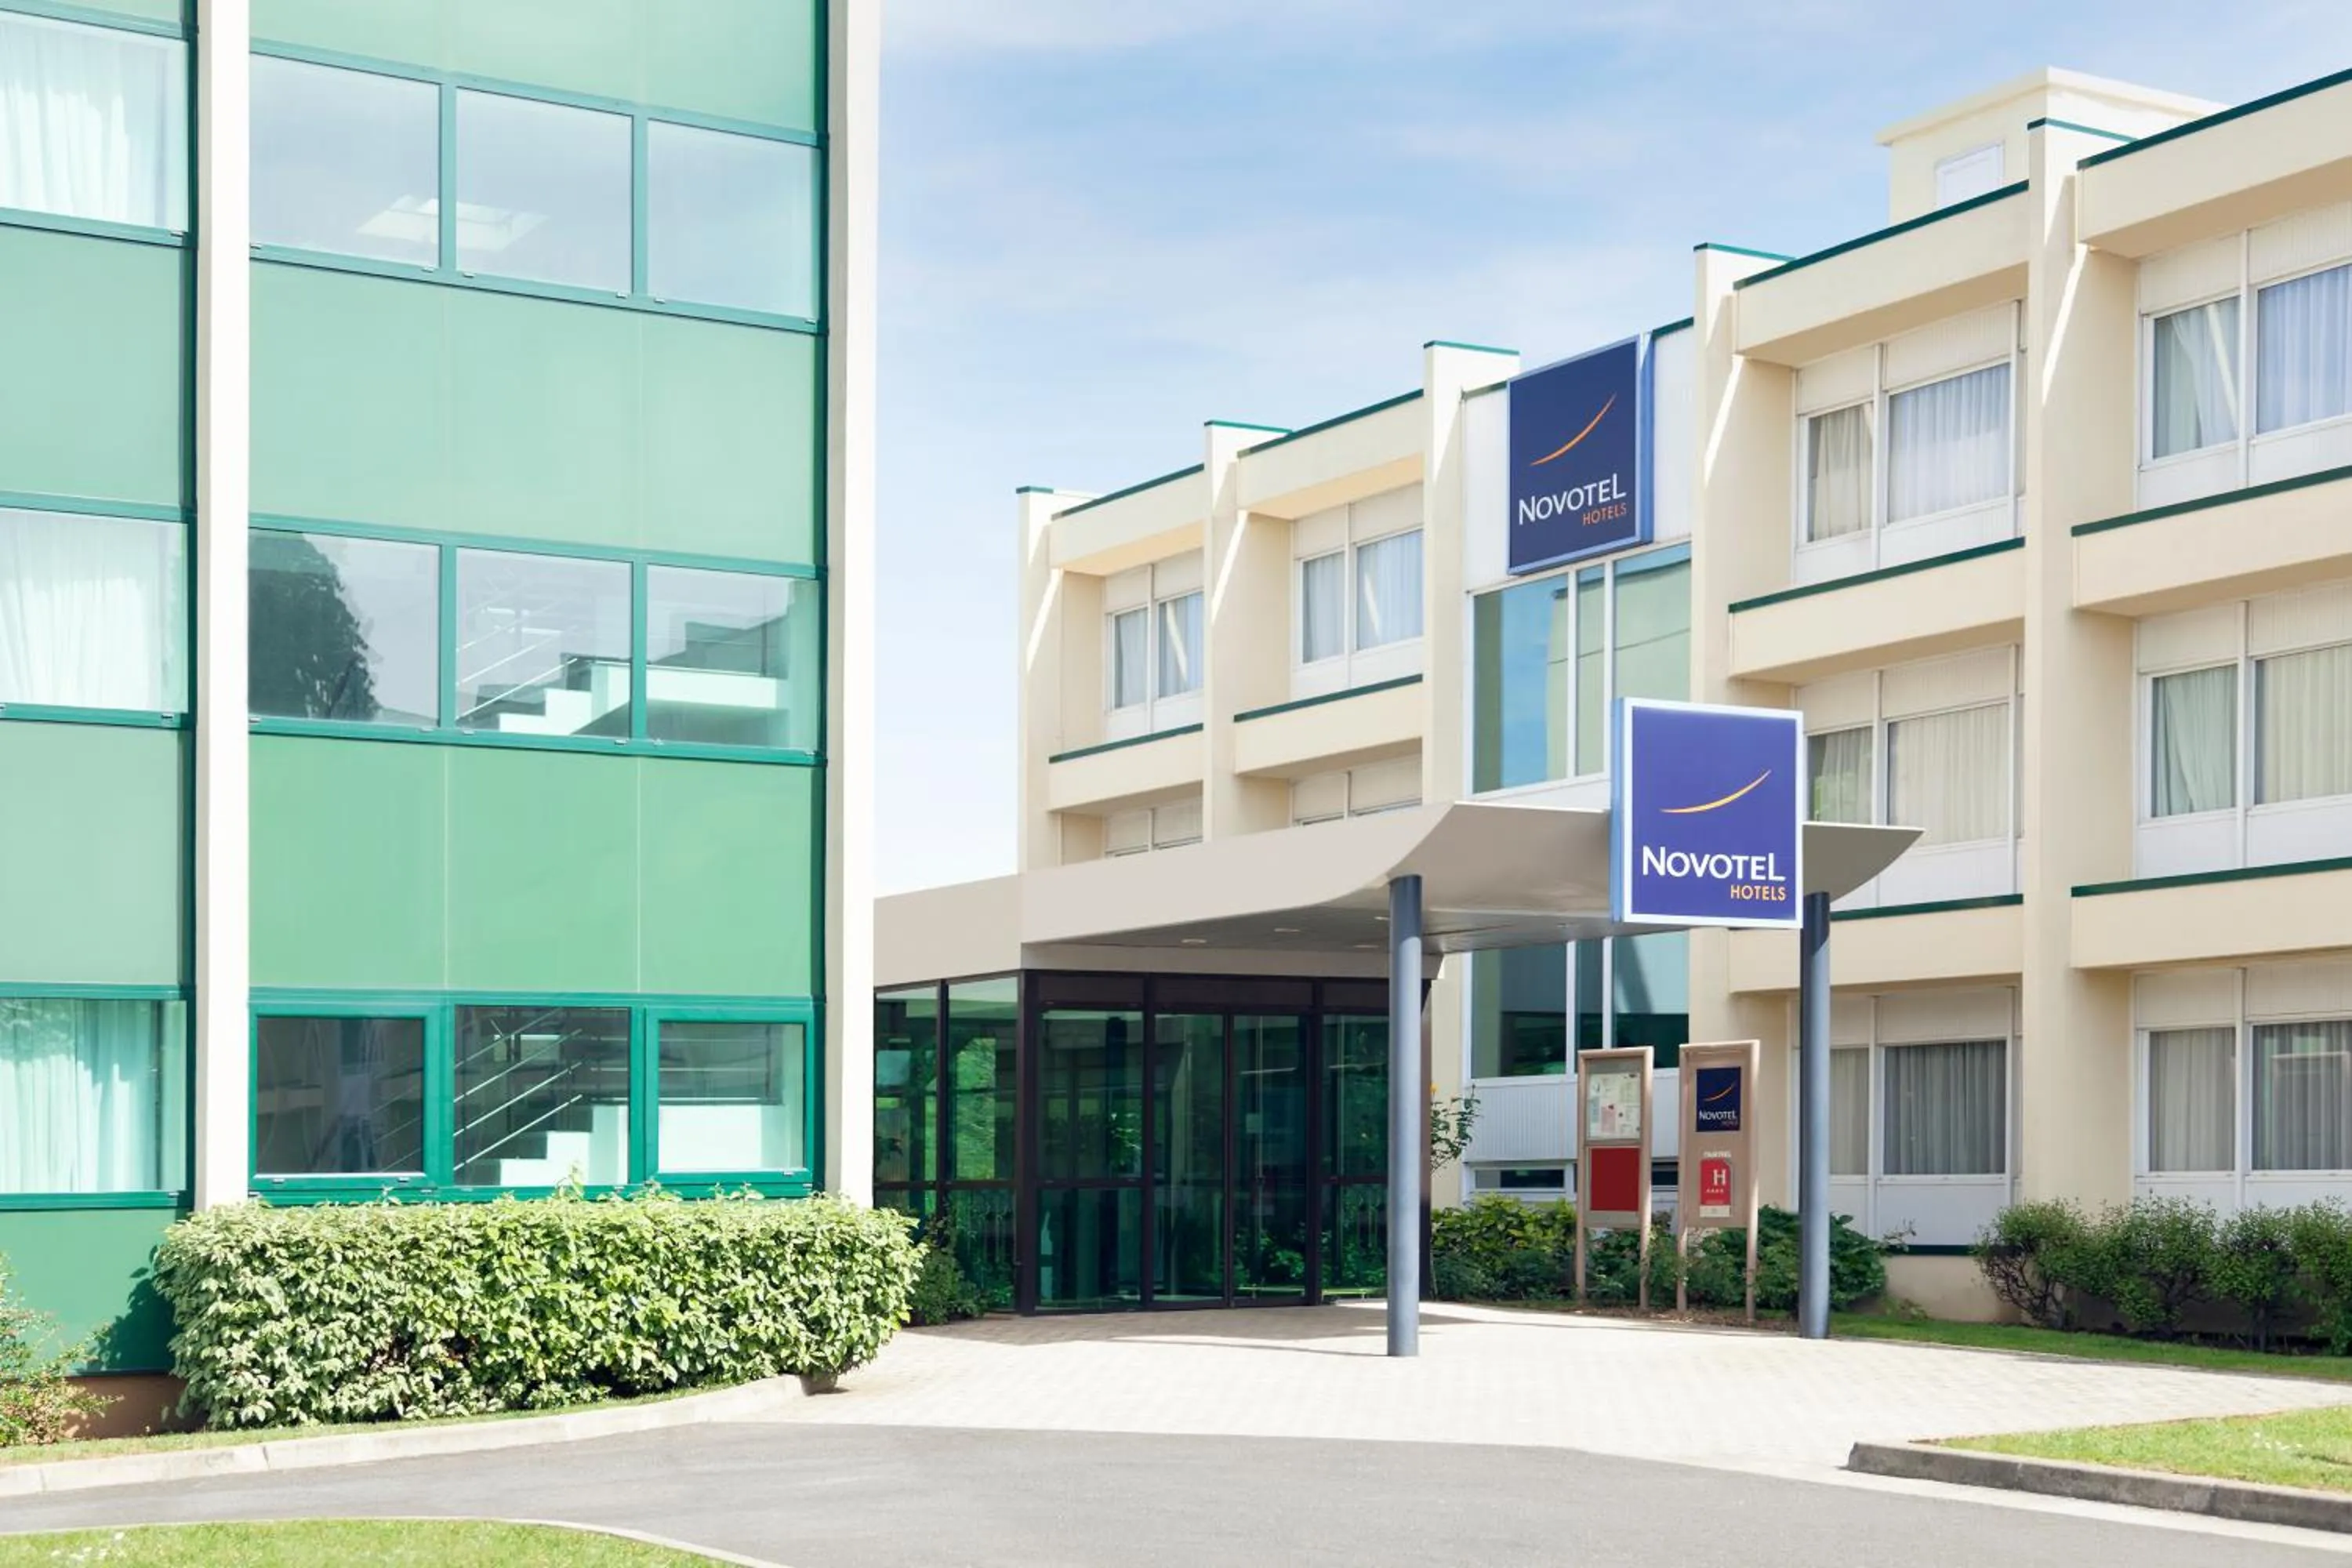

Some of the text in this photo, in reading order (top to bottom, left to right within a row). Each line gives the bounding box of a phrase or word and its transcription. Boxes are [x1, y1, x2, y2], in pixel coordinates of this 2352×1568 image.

[1519, 473, 1627, 525] NOVOTEL
[1582, 503, 1627, 526] HOTELS
[1642, 845, 1786, 882] NOVOTEL
[1730, 884, 1786, 902] HOTELS
[1699, 1109, 1737, 1121] NOVOTEL
[1713, 1169, 1726, 1186] H
